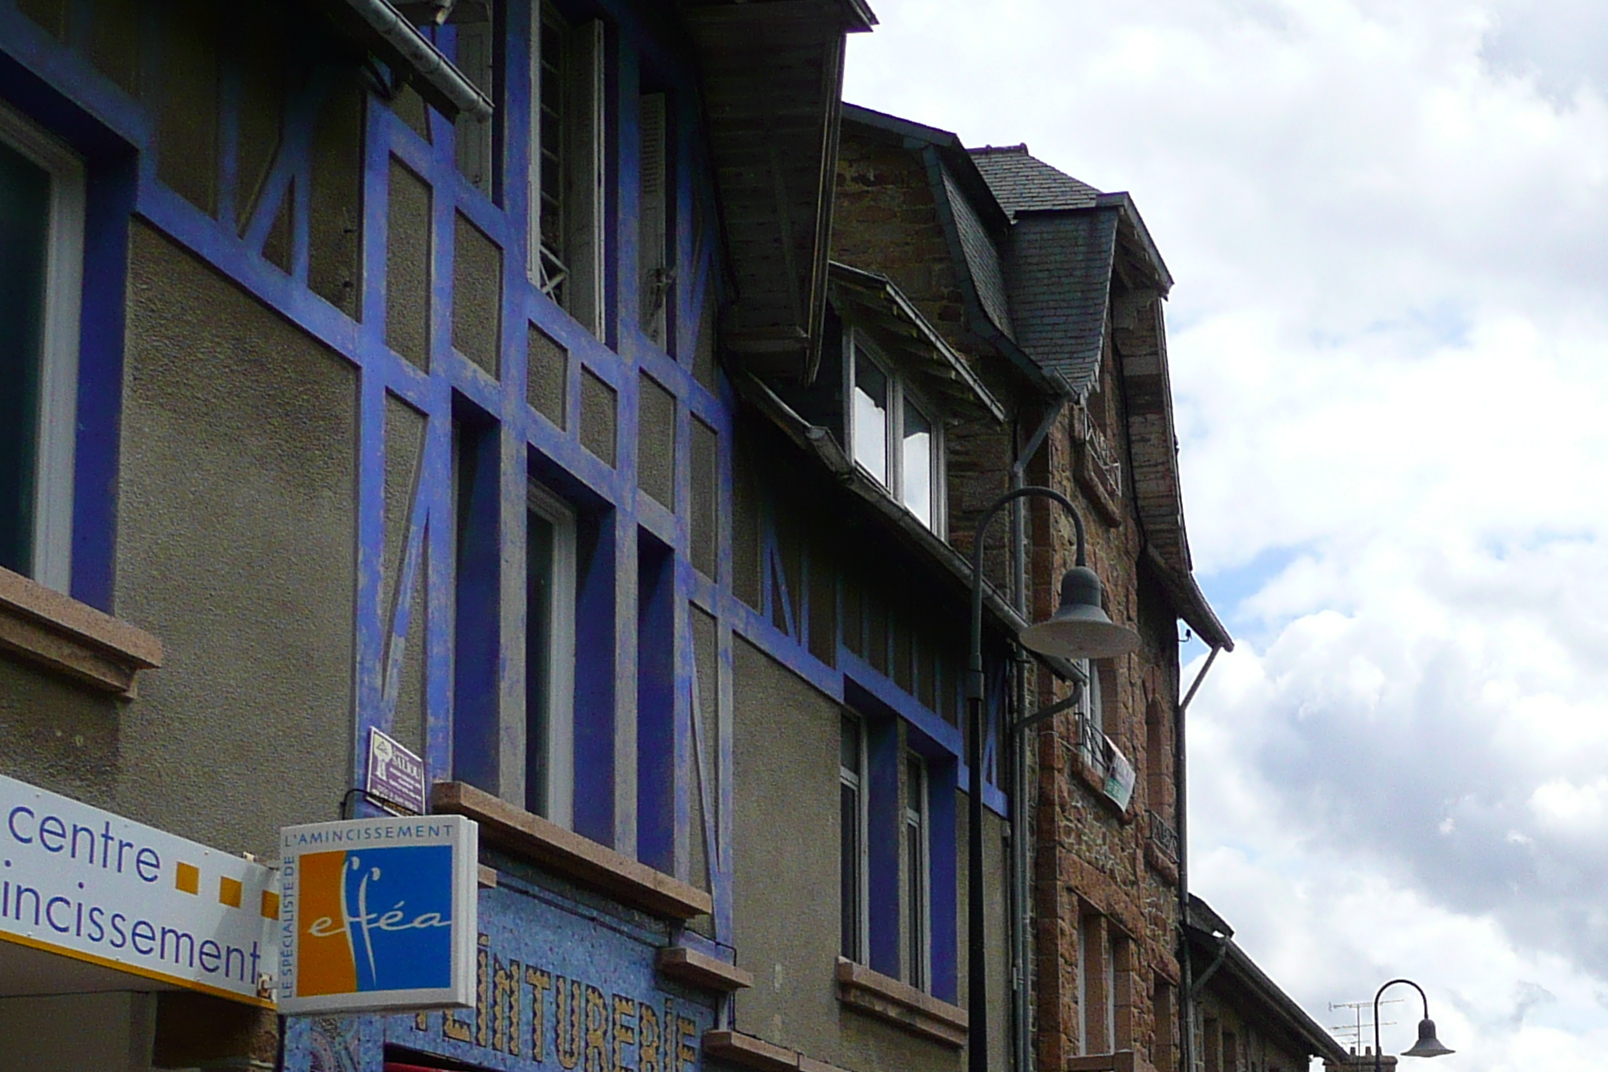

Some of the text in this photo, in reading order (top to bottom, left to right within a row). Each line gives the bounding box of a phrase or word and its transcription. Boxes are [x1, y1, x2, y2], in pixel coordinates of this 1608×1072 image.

[8, 804, 161, 883] centre
[284, 824, 454, 847] L'AMINCISSEMENT
[281, 855, 294, 999] LE SPÉCIALISTE DE
